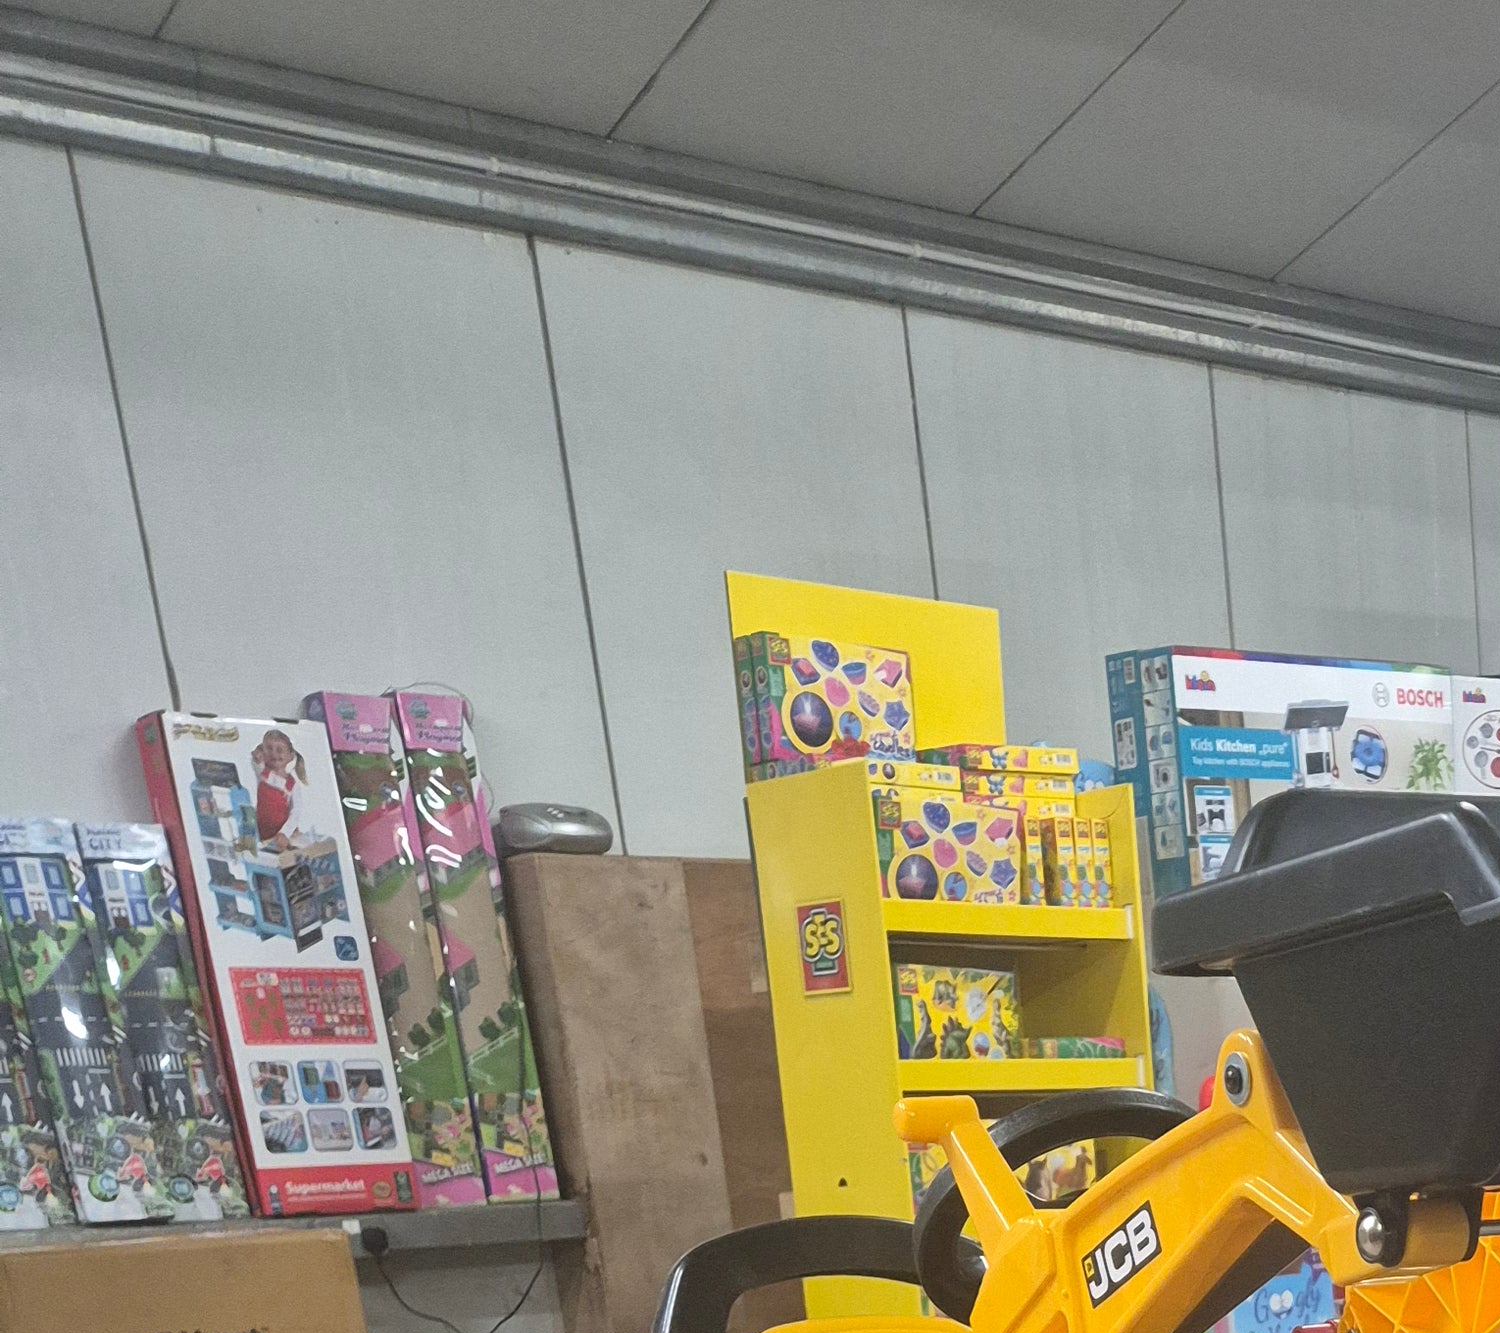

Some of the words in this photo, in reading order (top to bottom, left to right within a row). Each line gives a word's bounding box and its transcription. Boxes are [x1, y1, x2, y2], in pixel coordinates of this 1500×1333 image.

[1396, 688, 1444, 709] BOSCH
[1190, 738, 1214, 752] Kids
[1215, 738, 1257, 753] Kitchen
[804, 913, 840, 957] SES
[285, 1180, 365, 1194] Supermarket
[1089, 1209, 1157, 1299] JCB
